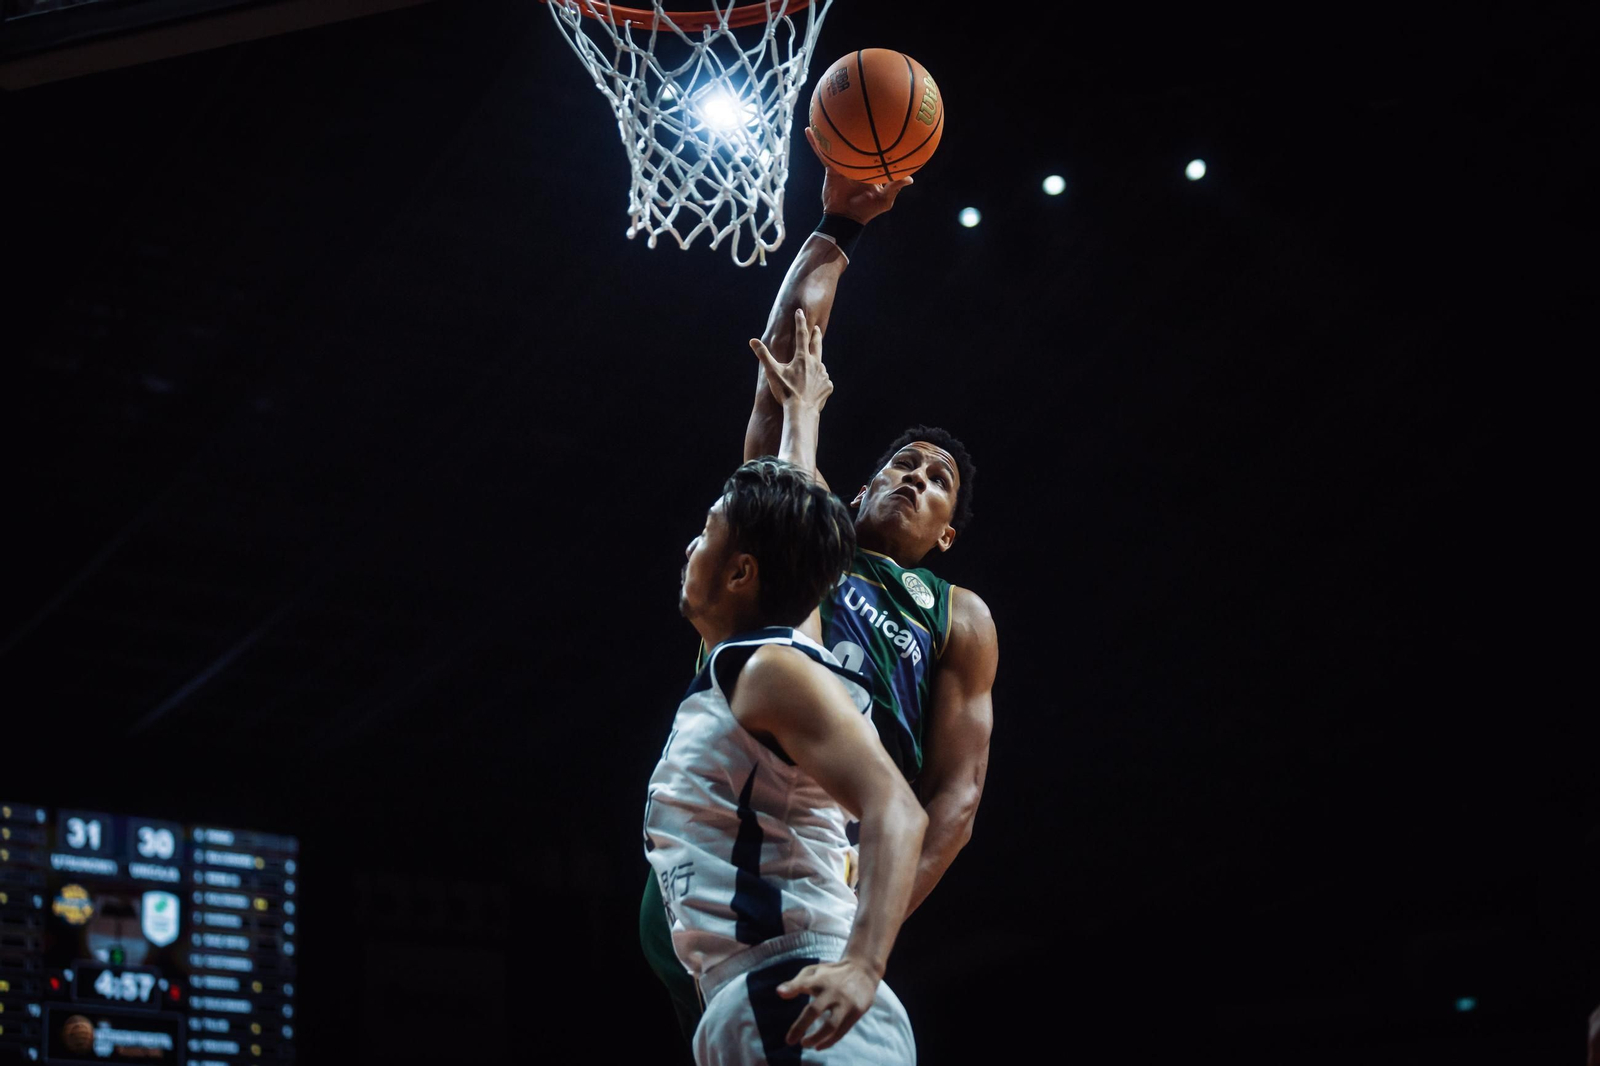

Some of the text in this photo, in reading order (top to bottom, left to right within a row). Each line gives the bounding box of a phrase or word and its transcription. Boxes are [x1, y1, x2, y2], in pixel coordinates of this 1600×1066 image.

[916, 73, 940, 126] Wil
[844, 586, 922, 667] Unicaja
[66, 816, 102, 851] 31
[136, 825, 175, 860] 30
[94, 969, 155, 1002] 4:57
